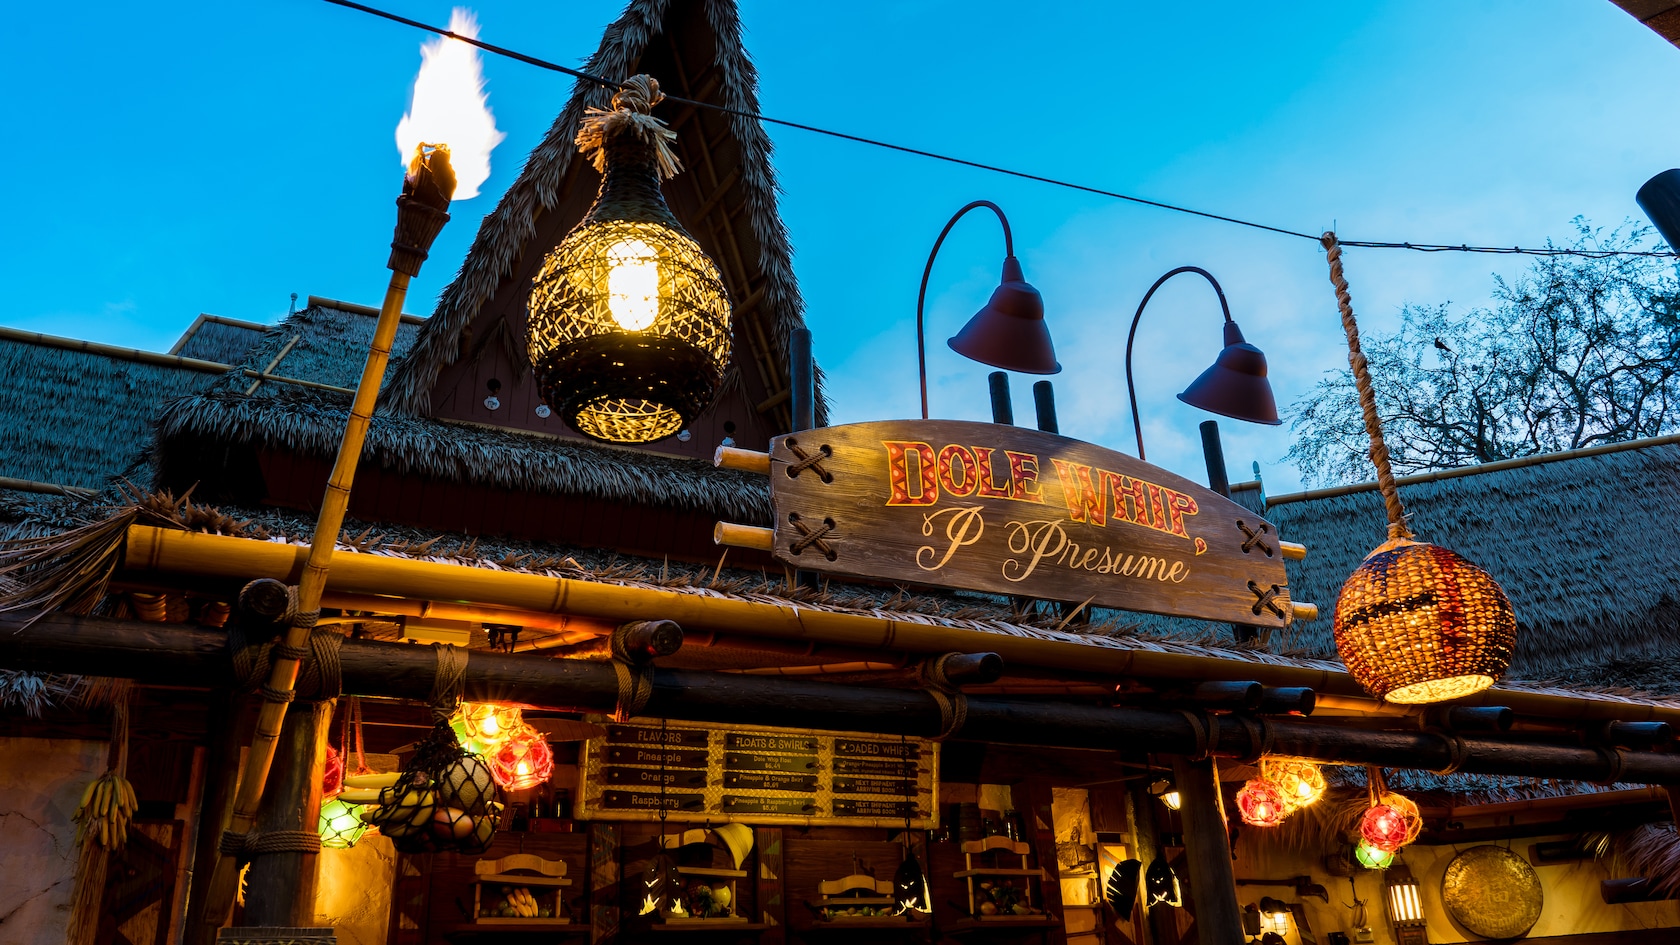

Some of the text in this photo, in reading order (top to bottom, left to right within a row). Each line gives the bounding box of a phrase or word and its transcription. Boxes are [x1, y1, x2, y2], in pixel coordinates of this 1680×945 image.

[881, 440, 1045, 507] DOLE
[1001, 518, 1190, 583] Presume
[638, 730, 682, 743] FLAVORS
[736, 737, 810, 751] FLOATS & SWIRLS
[844, 743, 910, 756] LOADED WHIPS
[637, 751, 682, 764] Pineaple
